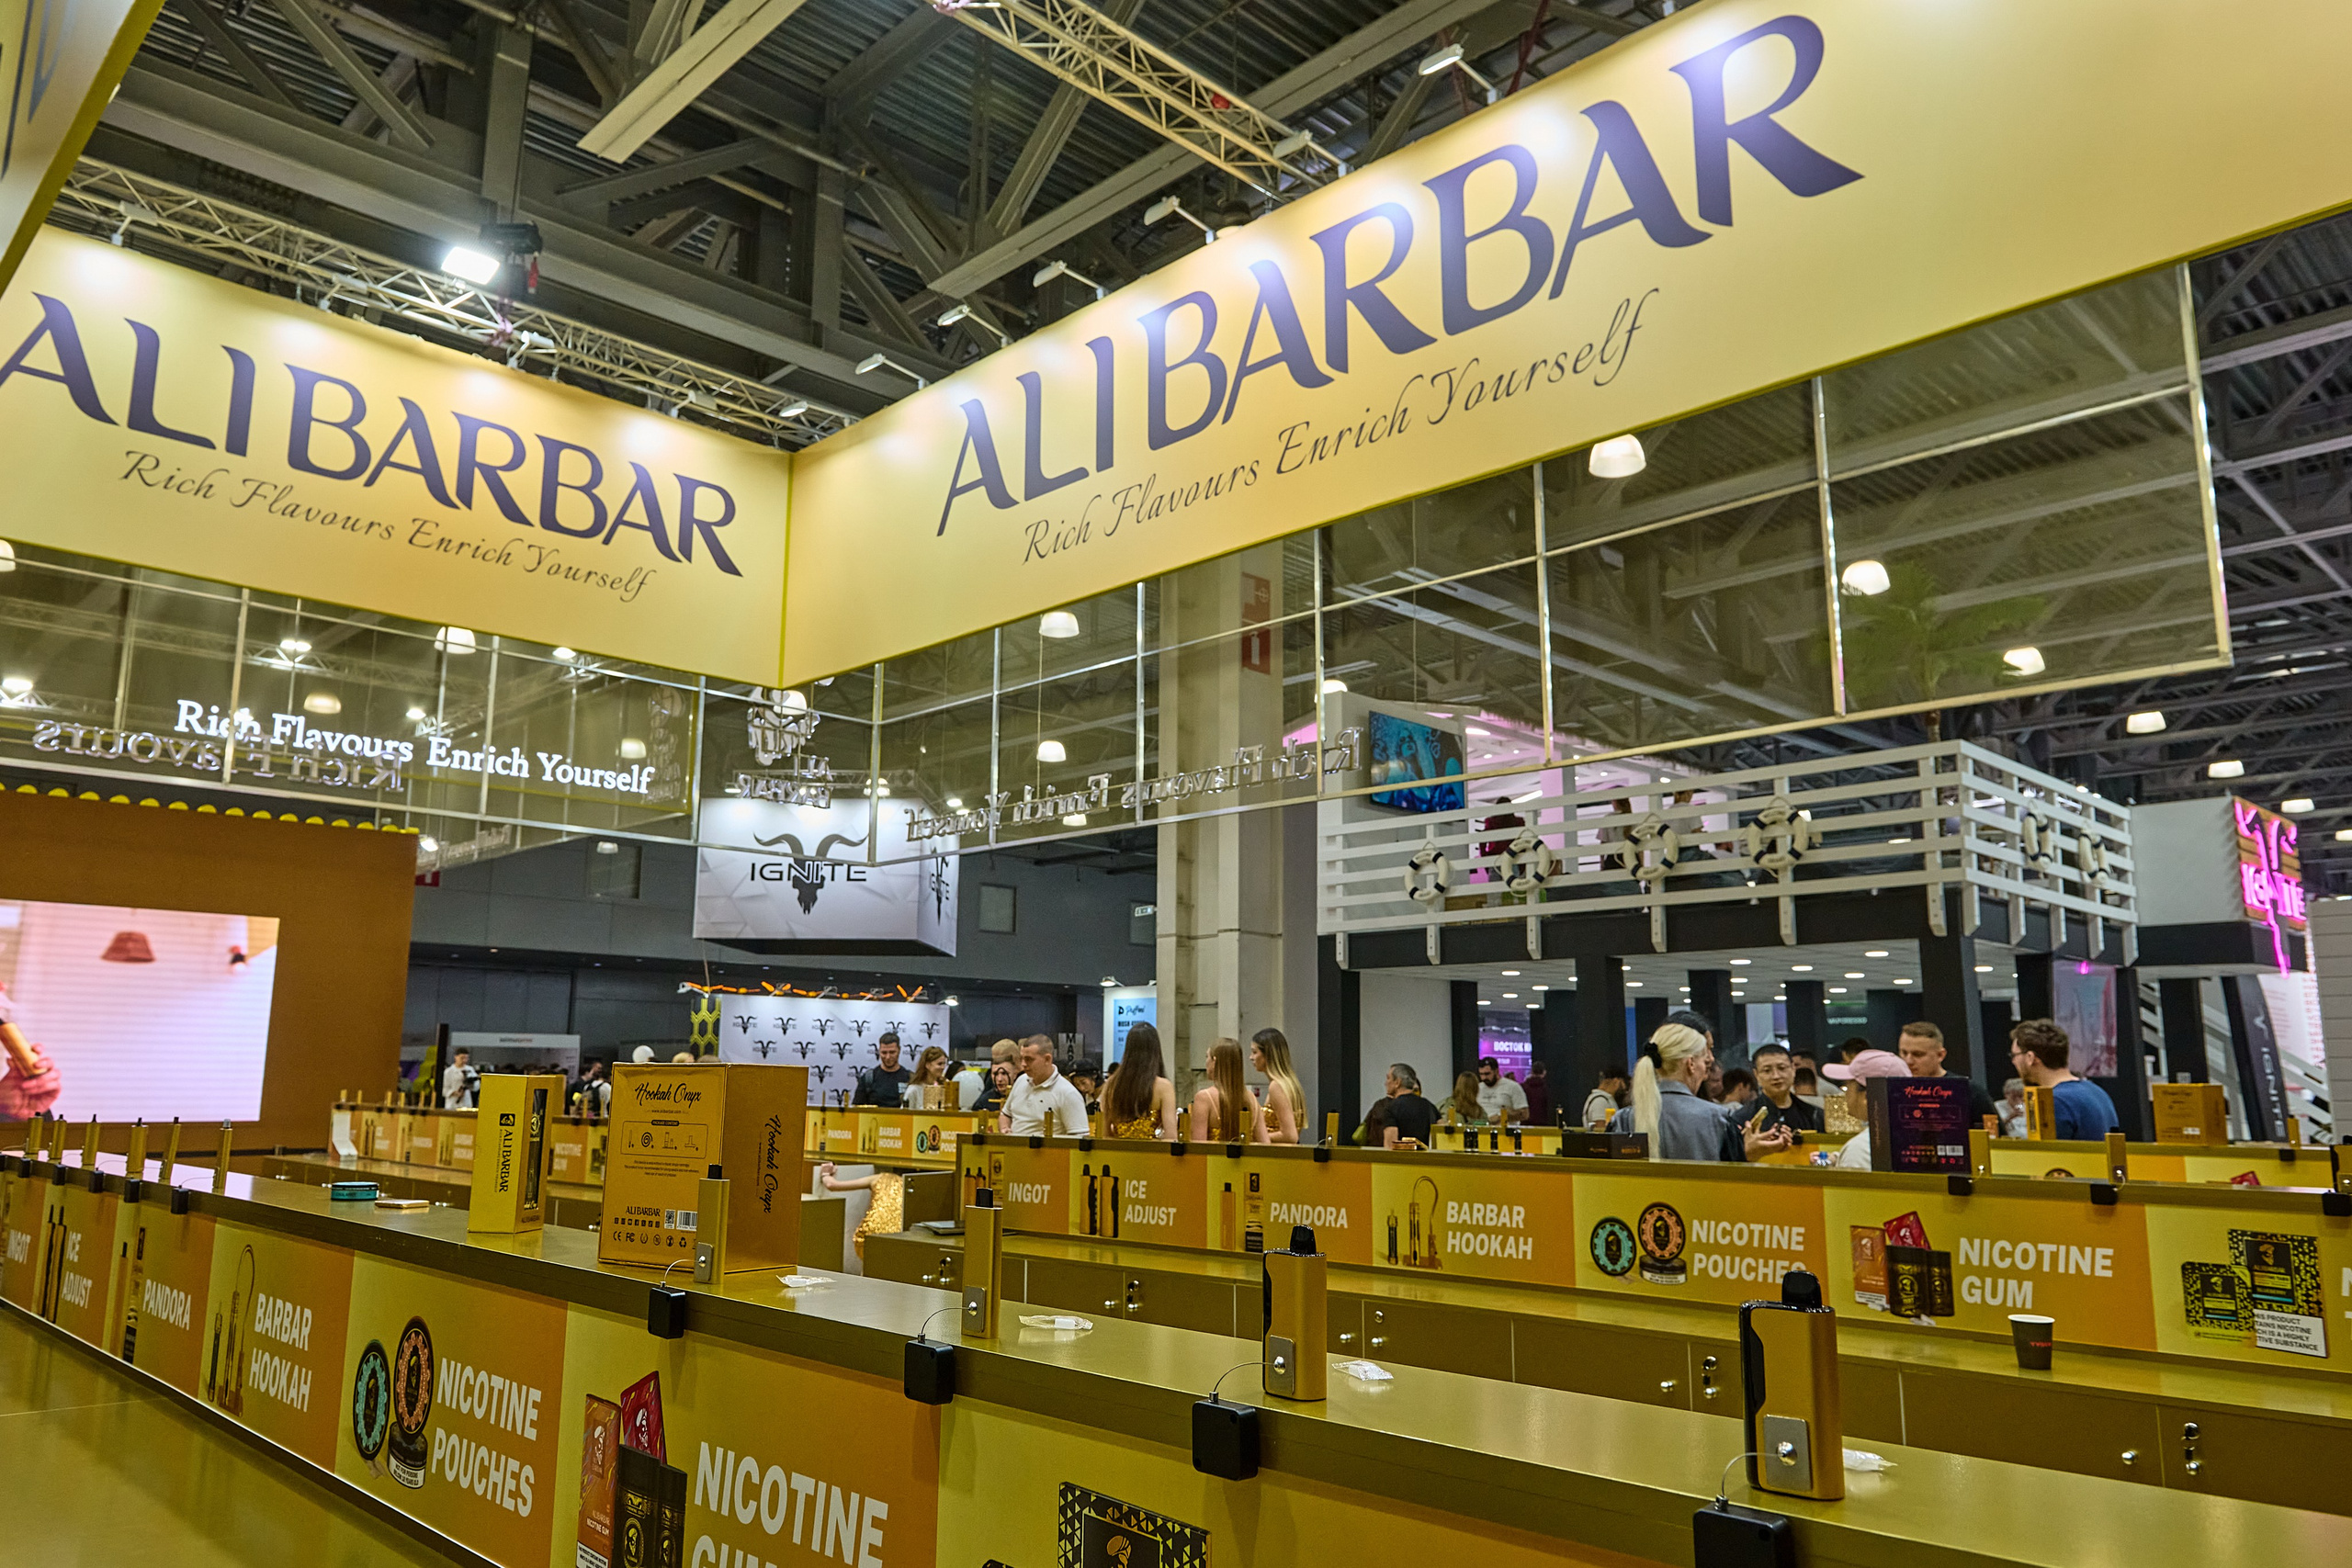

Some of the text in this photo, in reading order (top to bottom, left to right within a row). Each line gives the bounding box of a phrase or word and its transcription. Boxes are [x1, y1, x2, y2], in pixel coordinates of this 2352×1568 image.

[1023, 288, 1659, 566] Rich Flavours Enrich Yourself
[119, 450, 658, 603] Rich Flavours Enrich Yourself
[174, 699, 656, 795] Rich Flavours Enrich Yourself
[750, 861, 867, 884] IGNITE
[635, 1082, 702, 1109] Hookah Onyx
[759, 1114, 782, 1213] Hookah Onyx
[1008, 1182, 1051, 1205] INGOT
[1125, 1179, 1148, 1200] ICE
[1124, 1204, 1177, 1227] ADJUST
[1270, 1201, 1348, 1229] PANDORA
[1446, 1201, 1525, 1229] BARBAR
[1447, 1230, 1532, 1260] HOOKAH
[1691, 1219, 1805, 1252] NICOTINE
[1959, 1236, 2114, 1278] NICOTINE
[62, 1271, 93, 1310] ADJUST
[142, 1279, 192, 1331] PANDORA
[1961, 1275, 2033, 1310] GUM
[254, 1292, 312, 1351] BARBAR
[248, 1347, 312, 1413] HOOKAH
[436, 1357, 542, 1442] NICOTINE
[431, 1427, 535, 1517] POUCHES
[694, 1440, 889, 1568] NICOTINE
